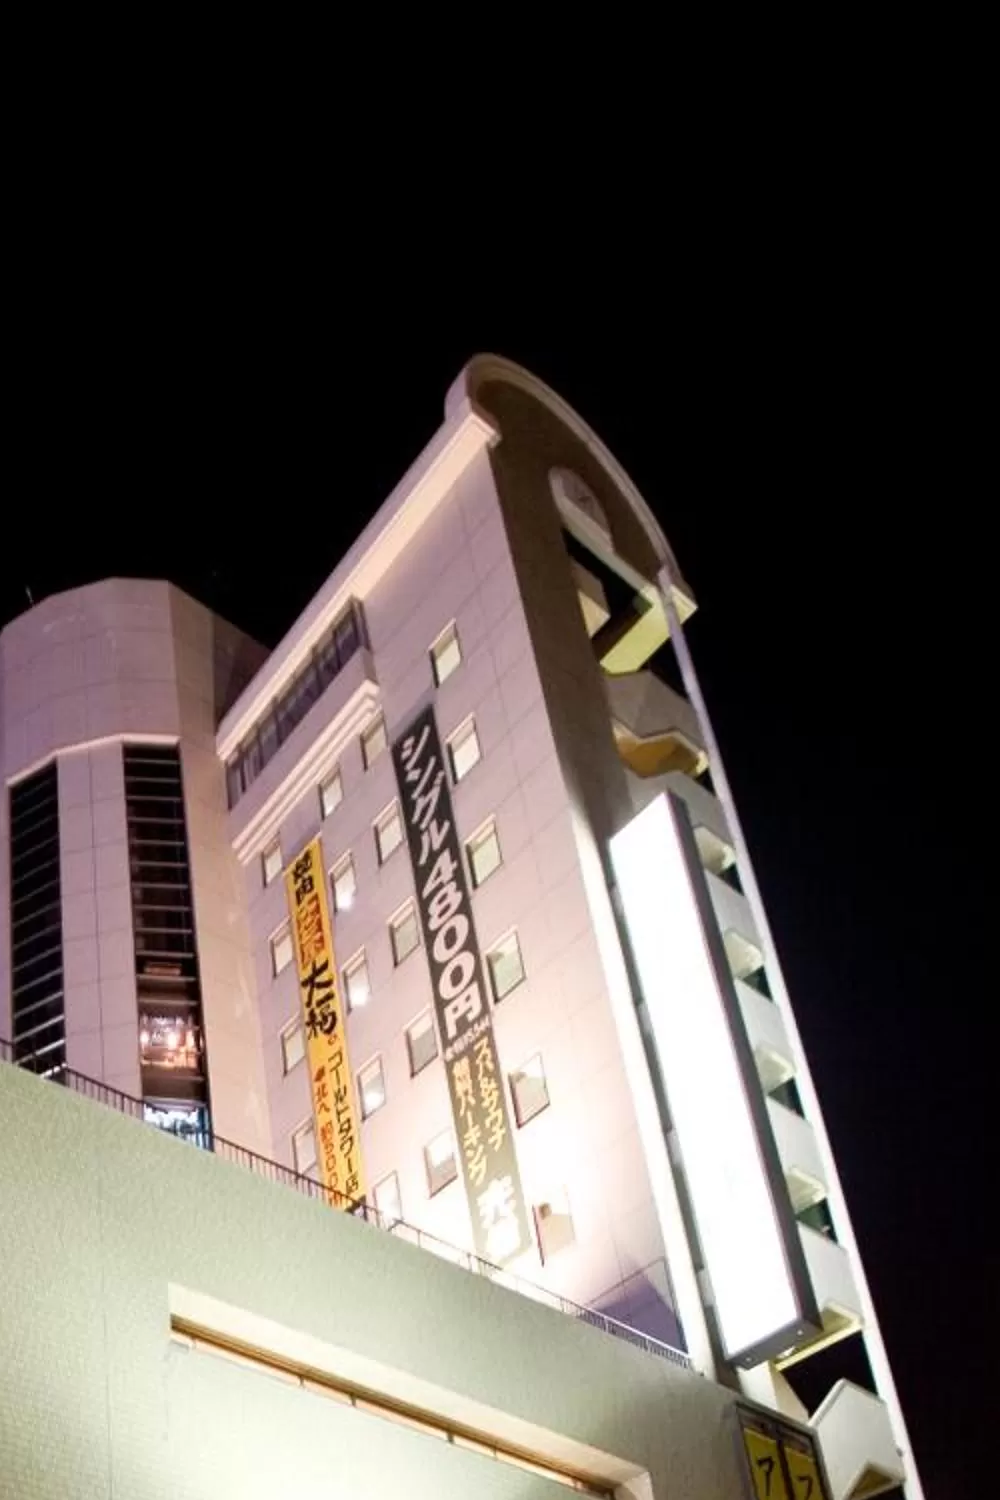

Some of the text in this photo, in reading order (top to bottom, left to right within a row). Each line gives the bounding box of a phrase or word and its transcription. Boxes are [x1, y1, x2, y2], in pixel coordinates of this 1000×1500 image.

[402, 725, 482, 1039] シングル4800円
